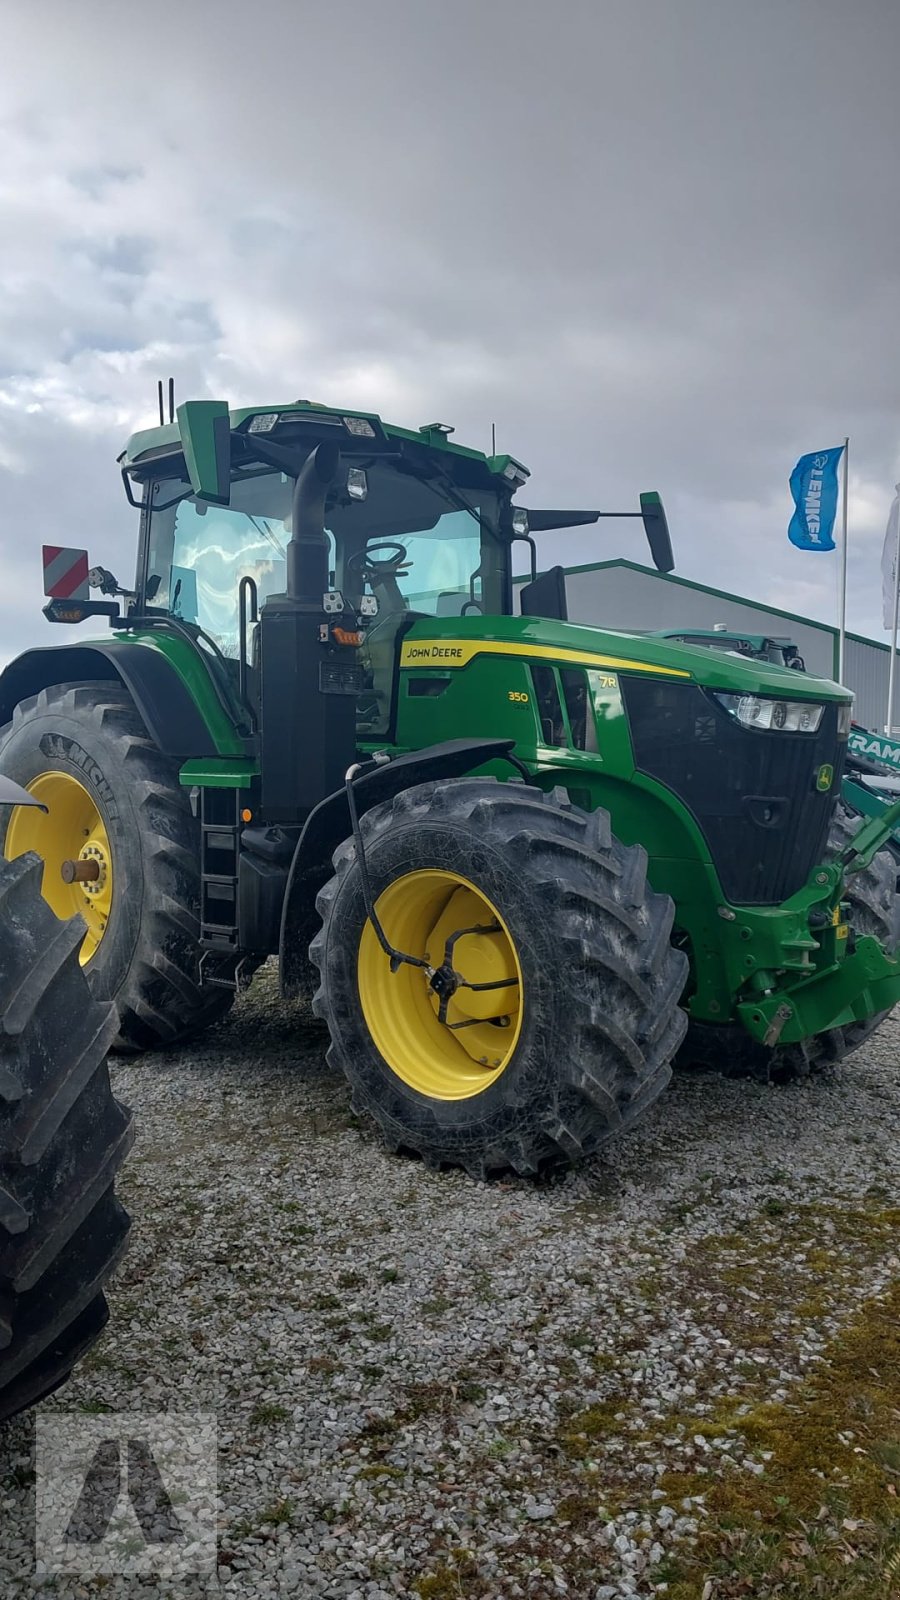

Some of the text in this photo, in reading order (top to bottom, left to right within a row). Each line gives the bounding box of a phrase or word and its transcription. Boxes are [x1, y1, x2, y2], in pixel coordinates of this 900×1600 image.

[406, 646, 464, 658] JOHN DEERE
[598, 675, 617, 689] 7R
[507, 691, 529, 703] 350
[847, 732, 900, 763] KRAM
[68, 742, 123, 860] MICHEL
